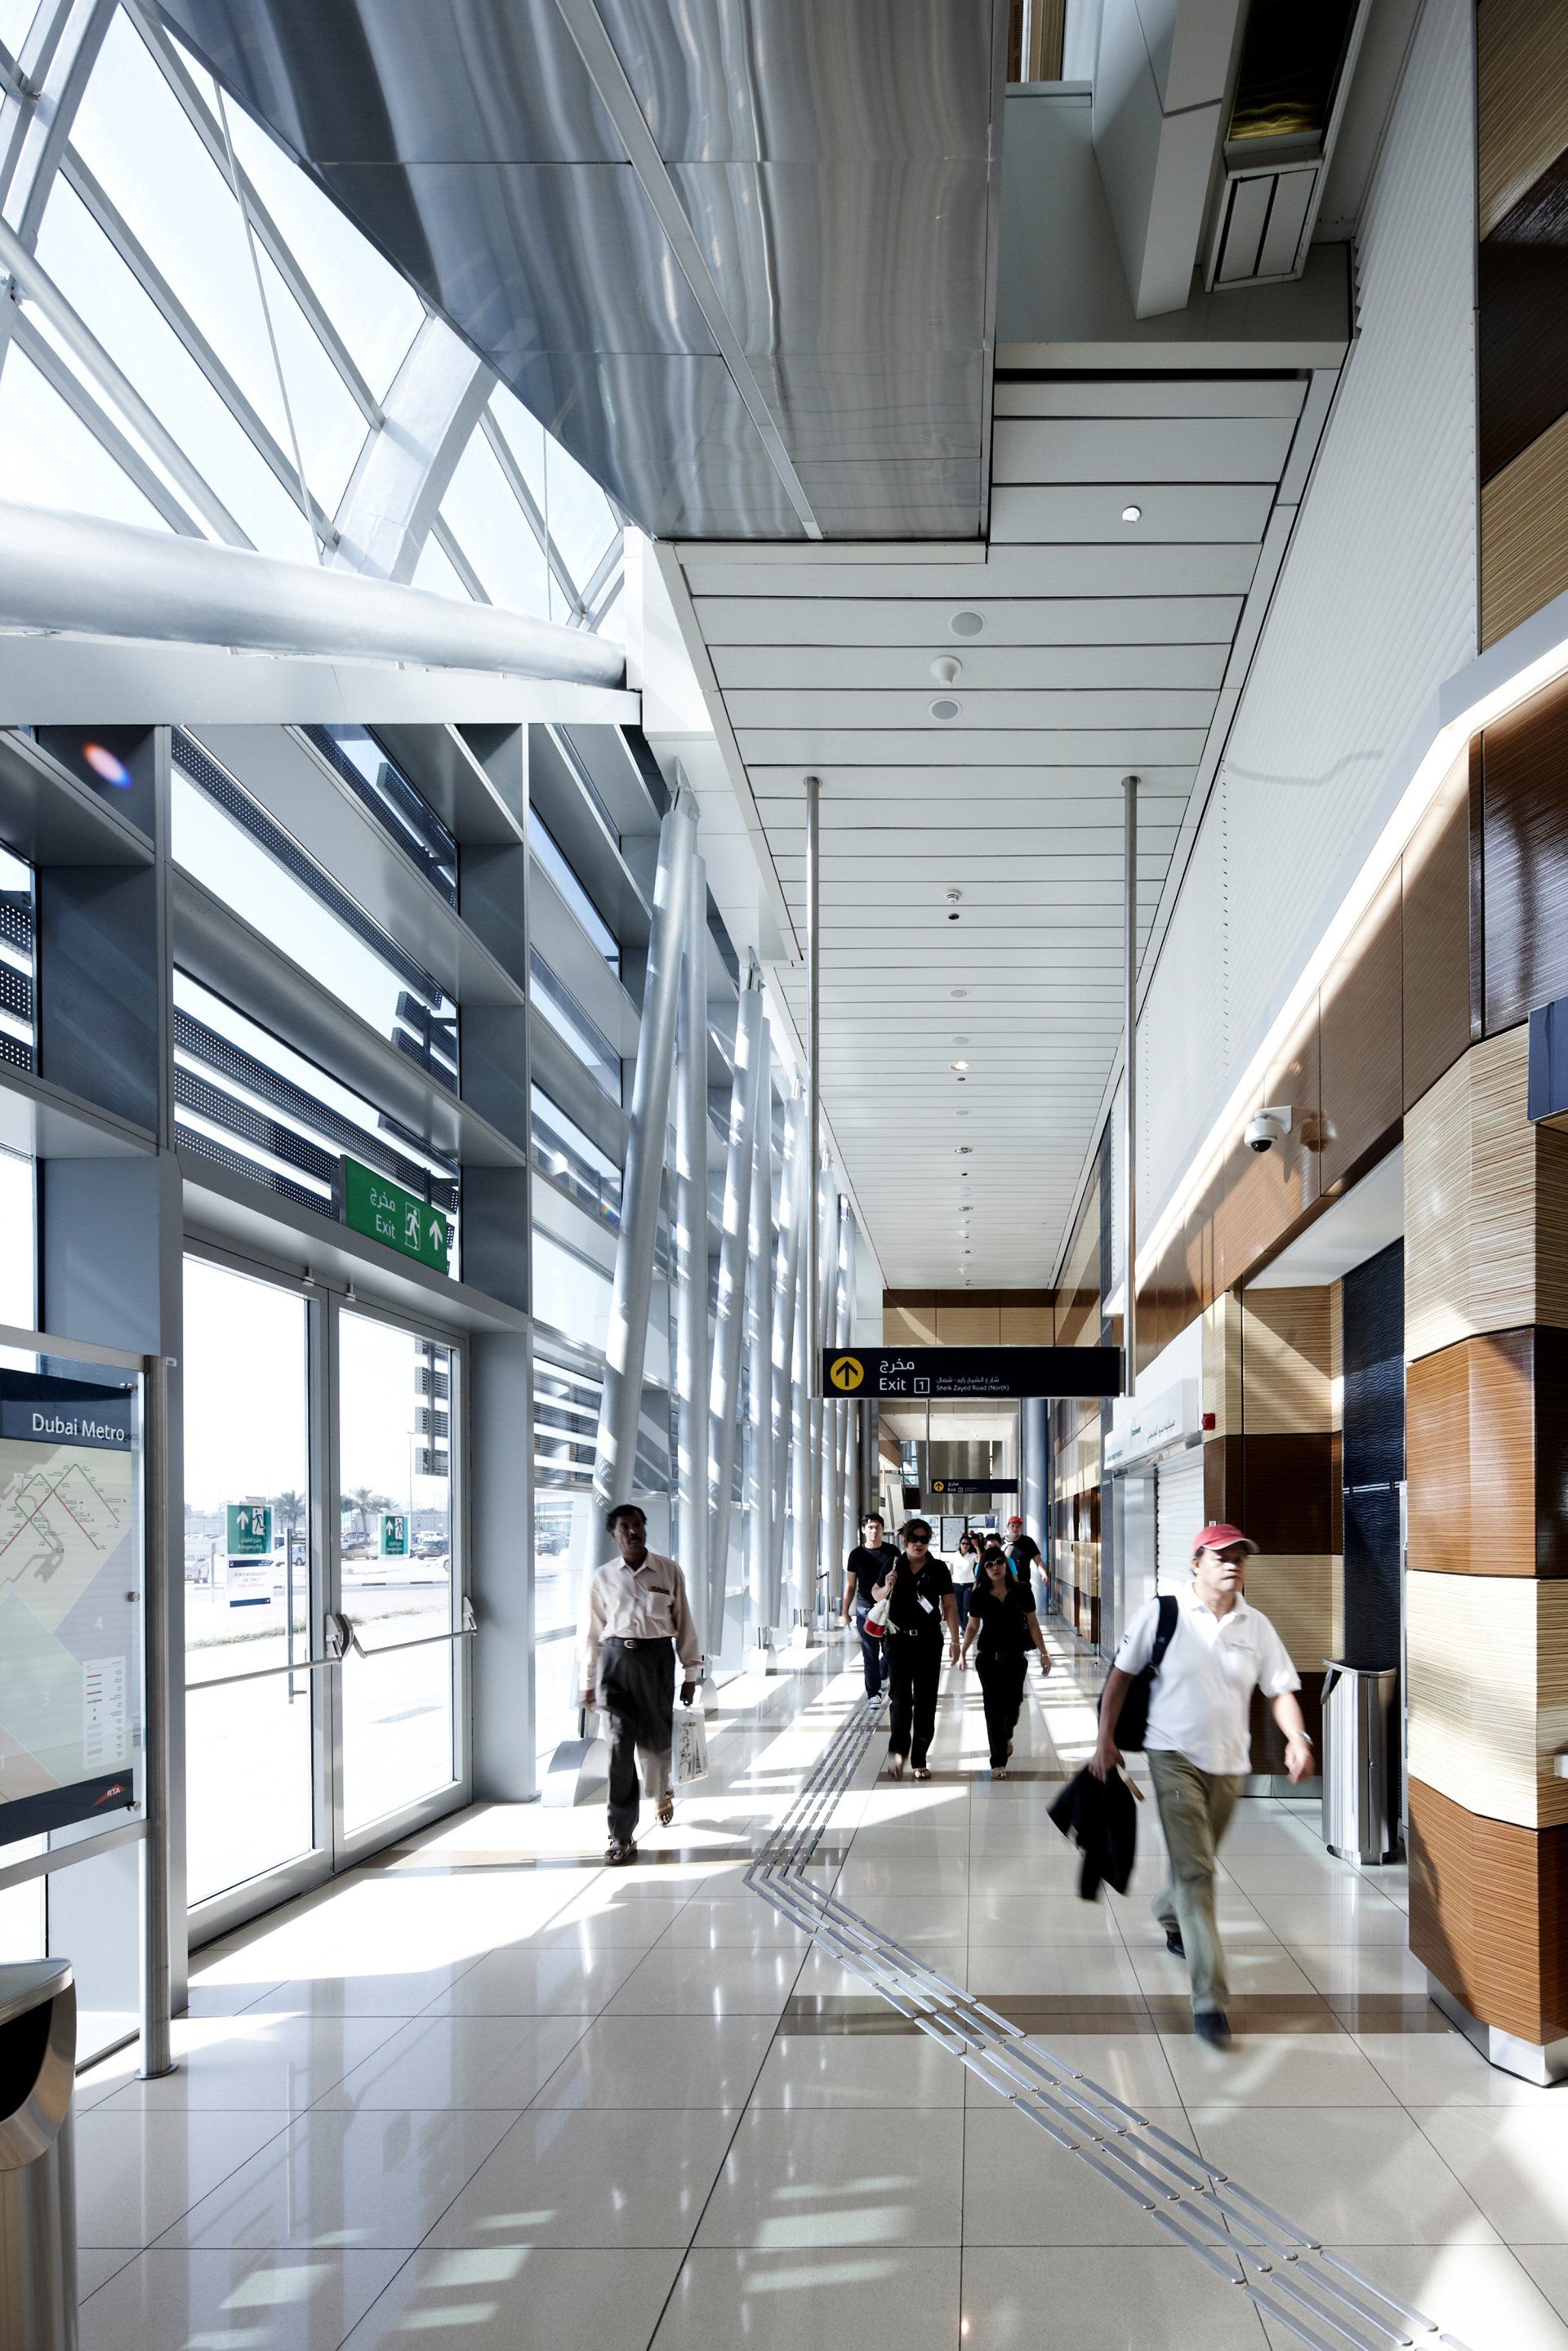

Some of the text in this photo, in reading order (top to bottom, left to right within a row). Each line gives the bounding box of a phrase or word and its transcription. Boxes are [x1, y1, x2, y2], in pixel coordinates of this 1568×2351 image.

[369, 1187, 396, 1212] مخرج
[376, 1213, 396, 1240] Exit
[879, 1358, 915, 1374] مخرج
[879, 1378, 924, 1391] Exit 1
[32, 1413, 125, 1441] Dubai Metro
[95, 1616, 104, 1630] 4
[42, 1691, 51, 1706] 3
[106, 1787, 122, 1797] RTA
